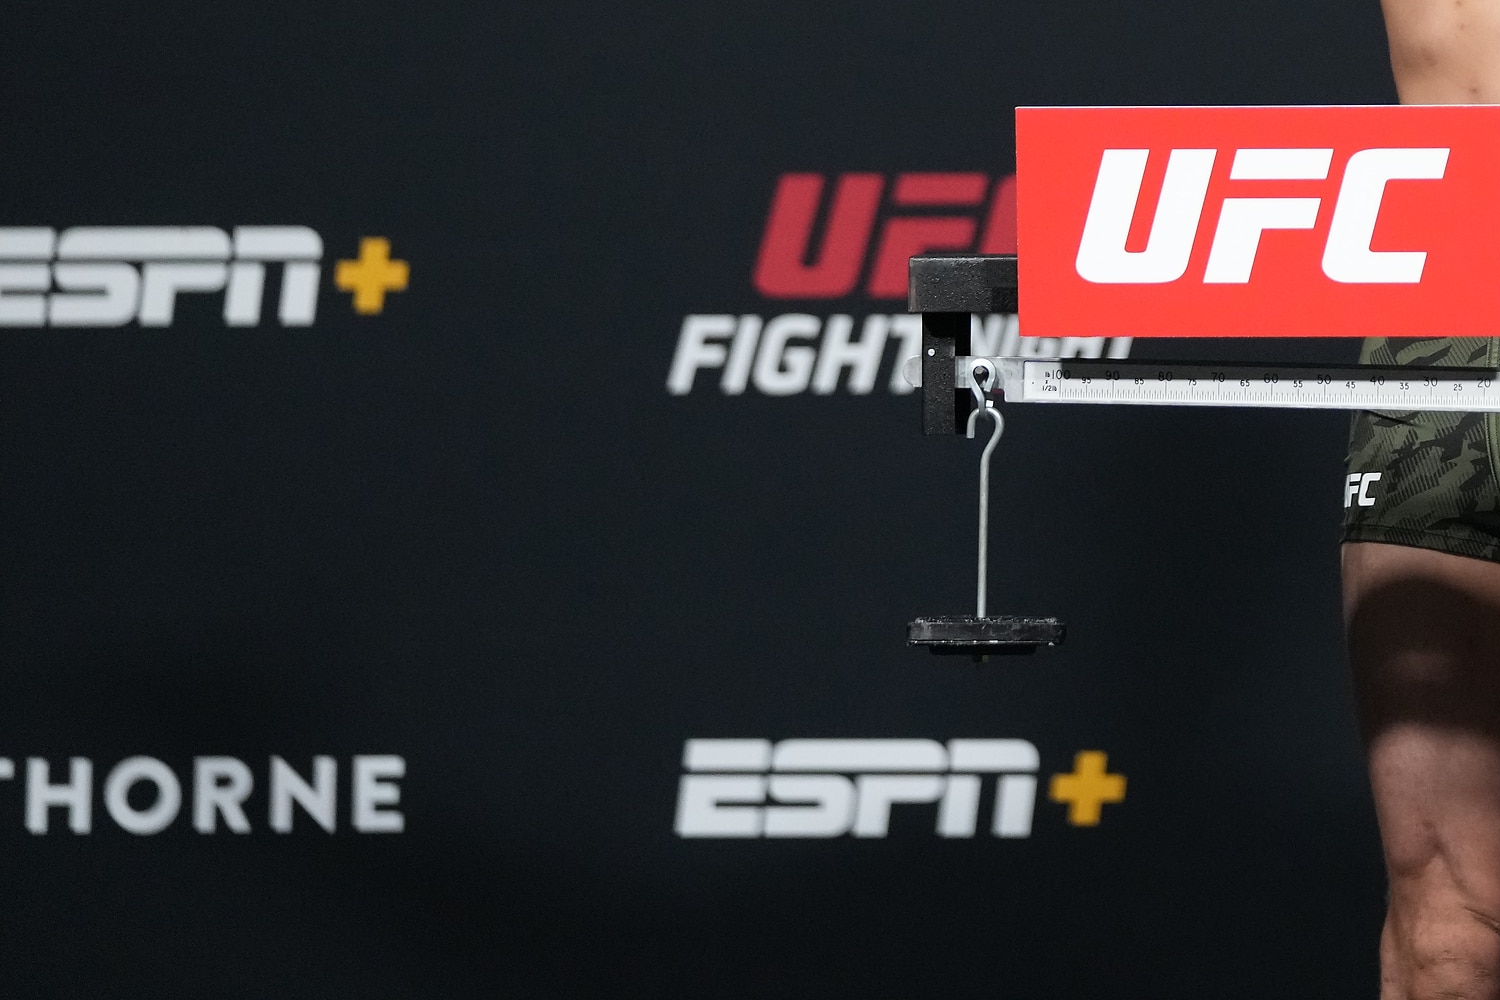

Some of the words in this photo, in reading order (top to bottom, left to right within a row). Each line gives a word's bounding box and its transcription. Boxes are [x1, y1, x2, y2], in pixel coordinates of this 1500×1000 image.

[1075, 148, 1450, 284] UFC
[1105, 370, 1120, 381] 90
[1158, 371, 1173, 382] 80
[1188, 378, 1197, 386] 75
[1211, 372, 1226, 383] 70
[1239, 379, 1250, 387] 65
[1263, 373, 1279, 384] 60
[1293, 380, 1303, 388] 55
[1317, 374, 1332, 385] 50
[1345, 381, 1356, 389] 45
[1369, 375, 1385, 386] 40
[1399, 382, 1410, 390] 35
[1423, 376, 1438, 387] 30
[1453, 383, 1463, 391] 25
[1477, 377, 1491, 388] 20
[1344, 472, 1382, 508] FC
[0, 755, 406, 836] HORNE
